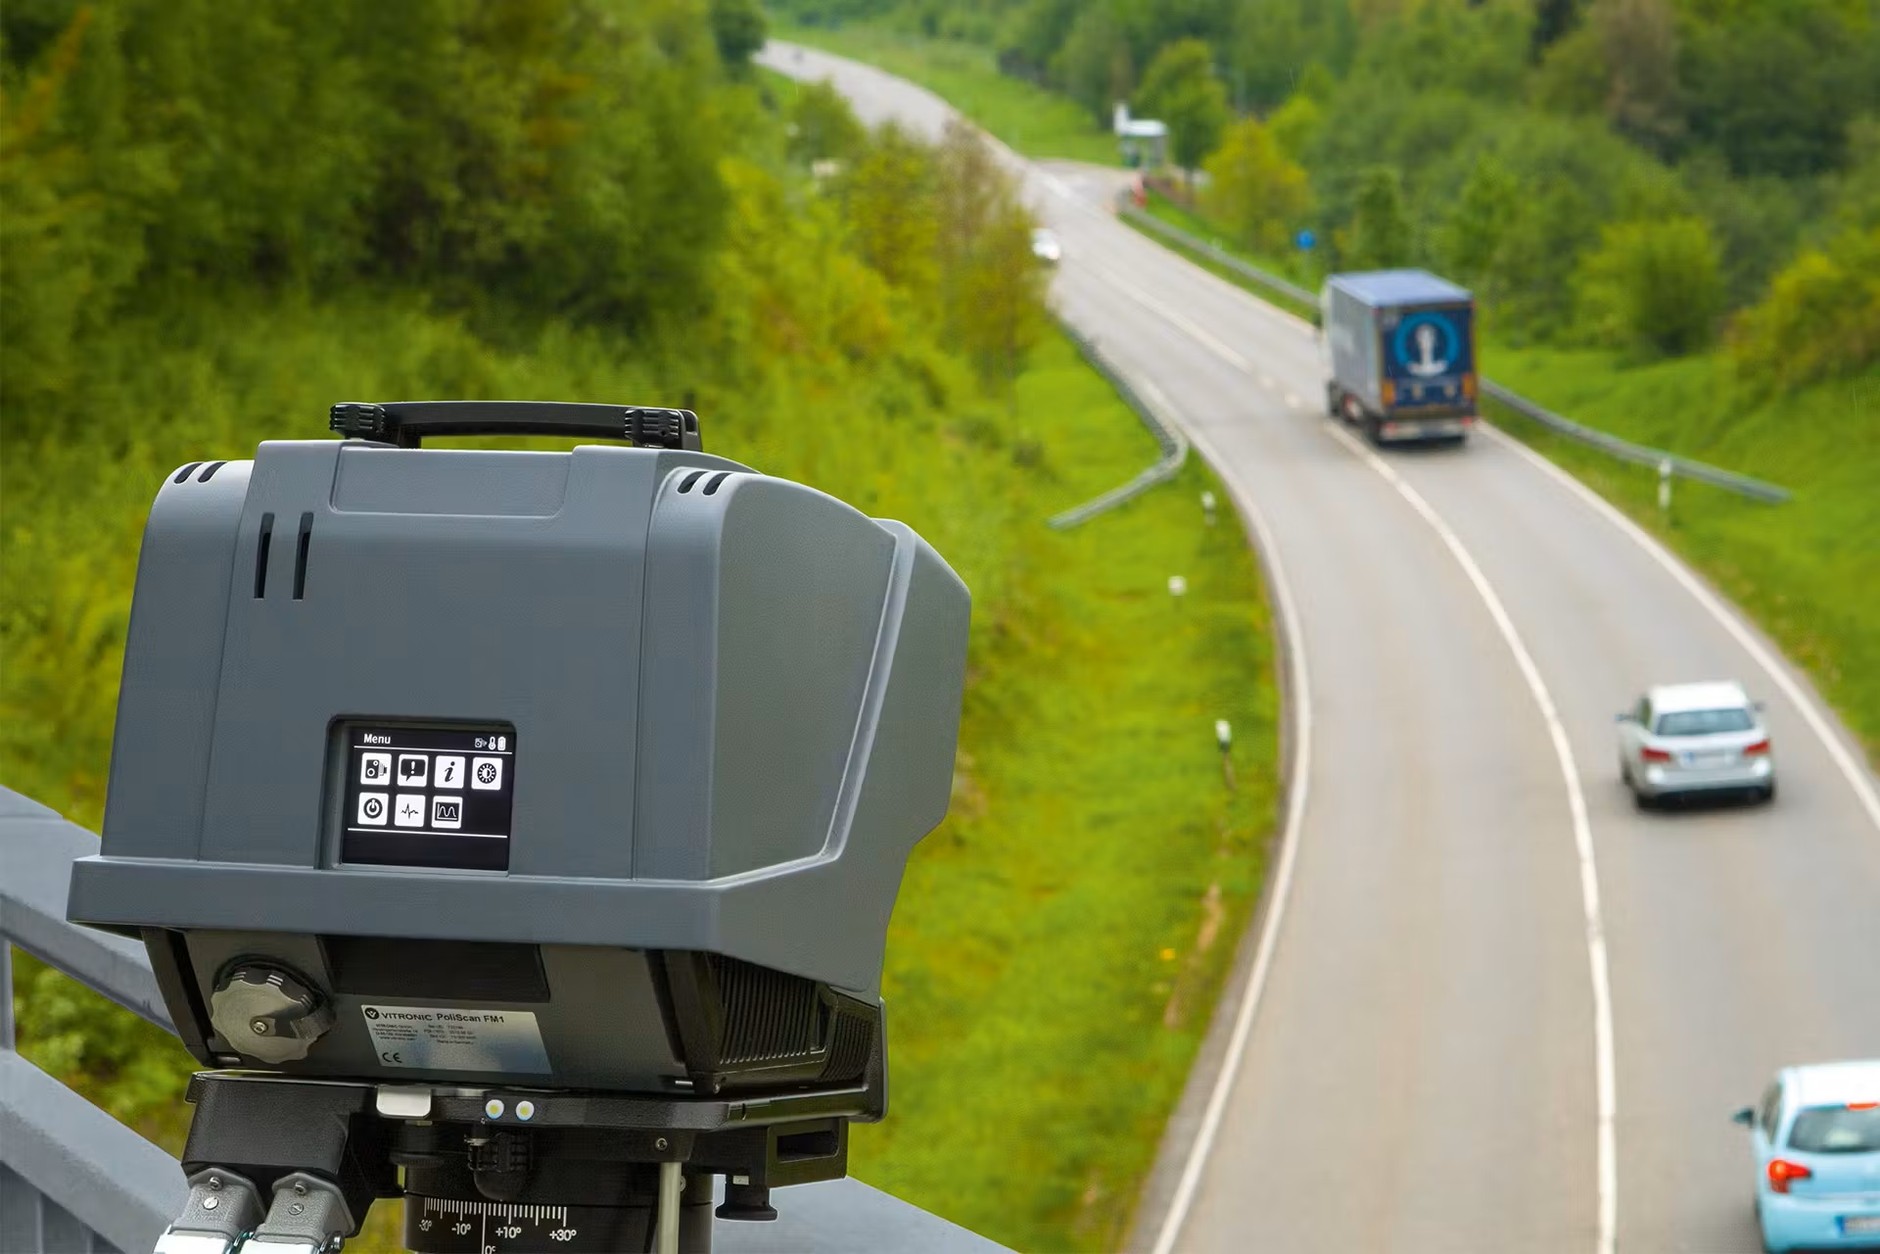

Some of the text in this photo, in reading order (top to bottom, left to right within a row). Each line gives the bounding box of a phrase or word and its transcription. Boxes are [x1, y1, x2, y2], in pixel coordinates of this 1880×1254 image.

[363, 733, 391, 745] Menu
[381, 1012, 505, 1024] VITRONIC PoliScan FM1
